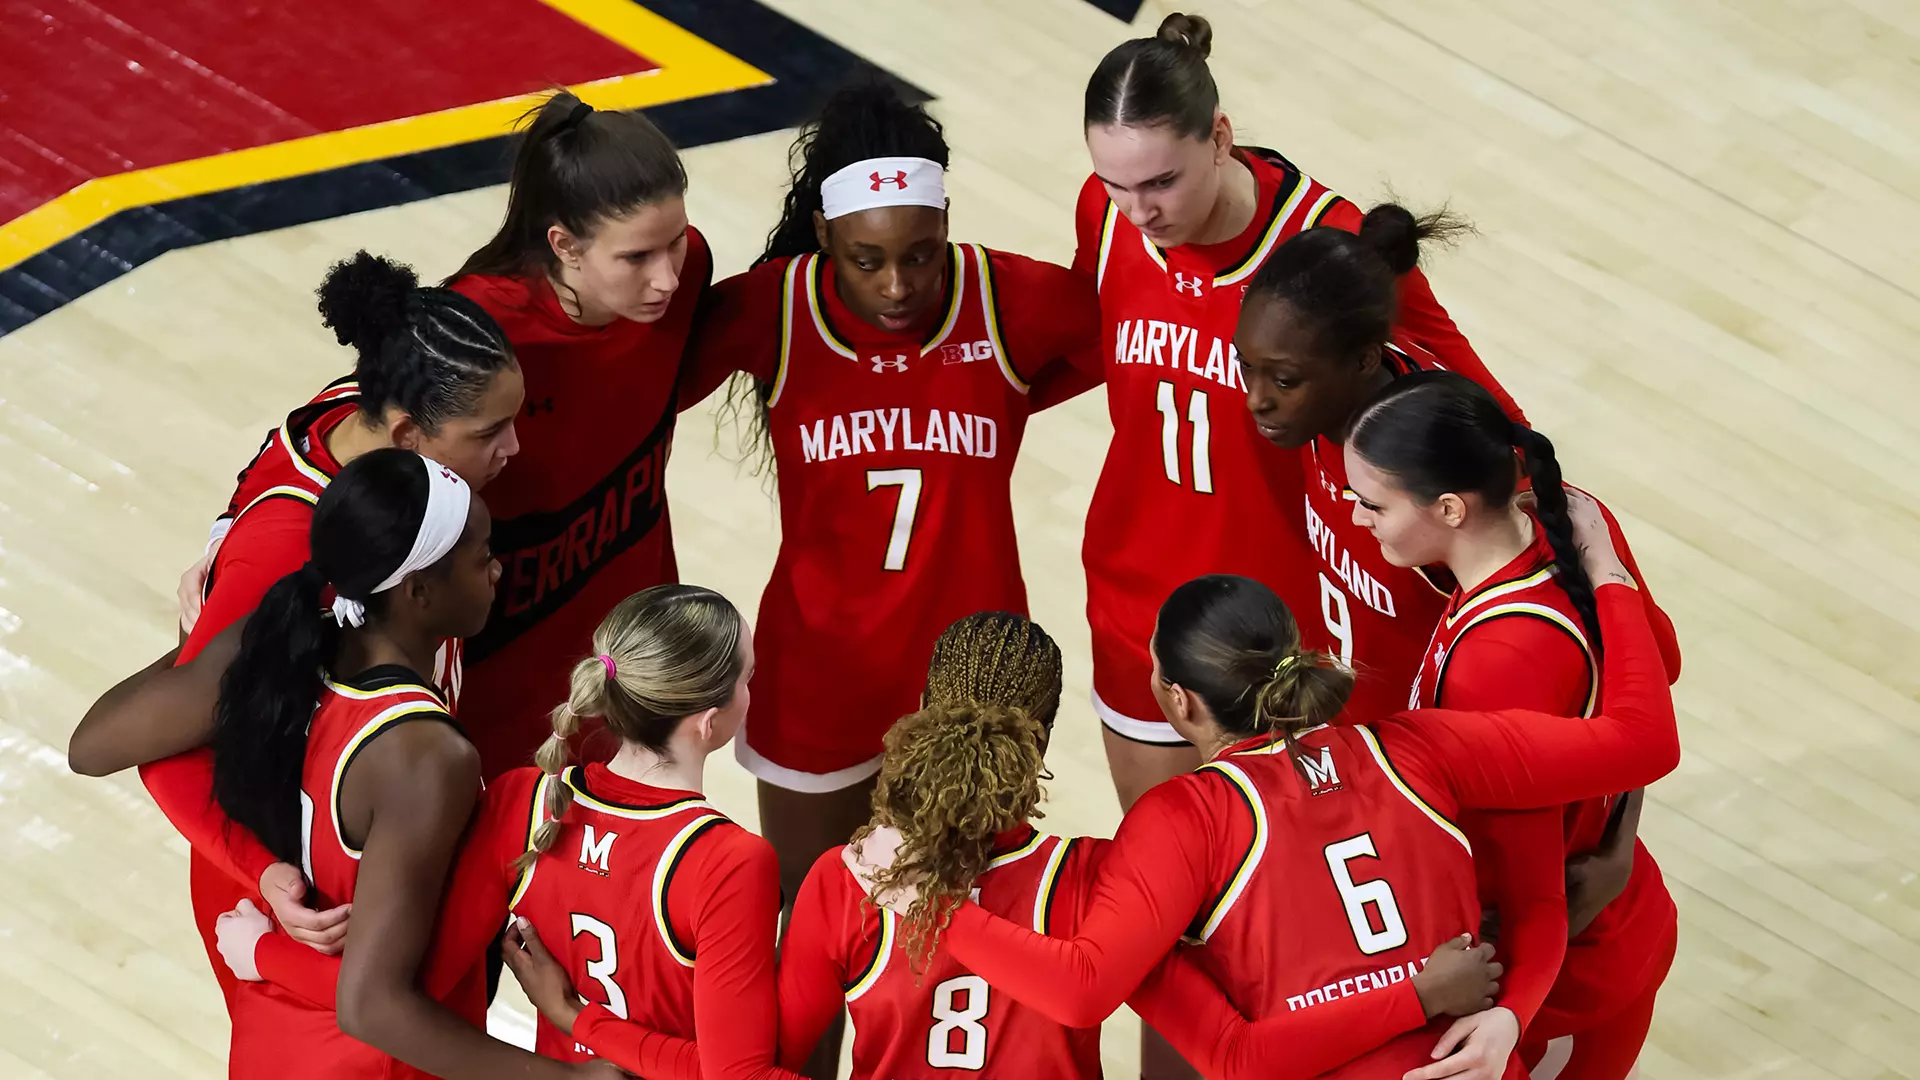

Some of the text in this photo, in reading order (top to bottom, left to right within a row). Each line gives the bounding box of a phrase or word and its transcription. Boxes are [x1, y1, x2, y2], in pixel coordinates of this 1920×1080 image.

[799, 408, 997, 463] MARYLAND
[1156, 379, 1215, 494] 11
[503, 436, 668, 617] ERRAPI
[865, 468, 923, 572] 7
[1318, 571, 1353, 678] 9
[1297, 746, 1341, 790] M
[578, 824, 619, 872] M
[1323, 830, 1409, 956] 6
[569, 912, 630, 1020] 3
[926, 973, 992, 1071] 8
